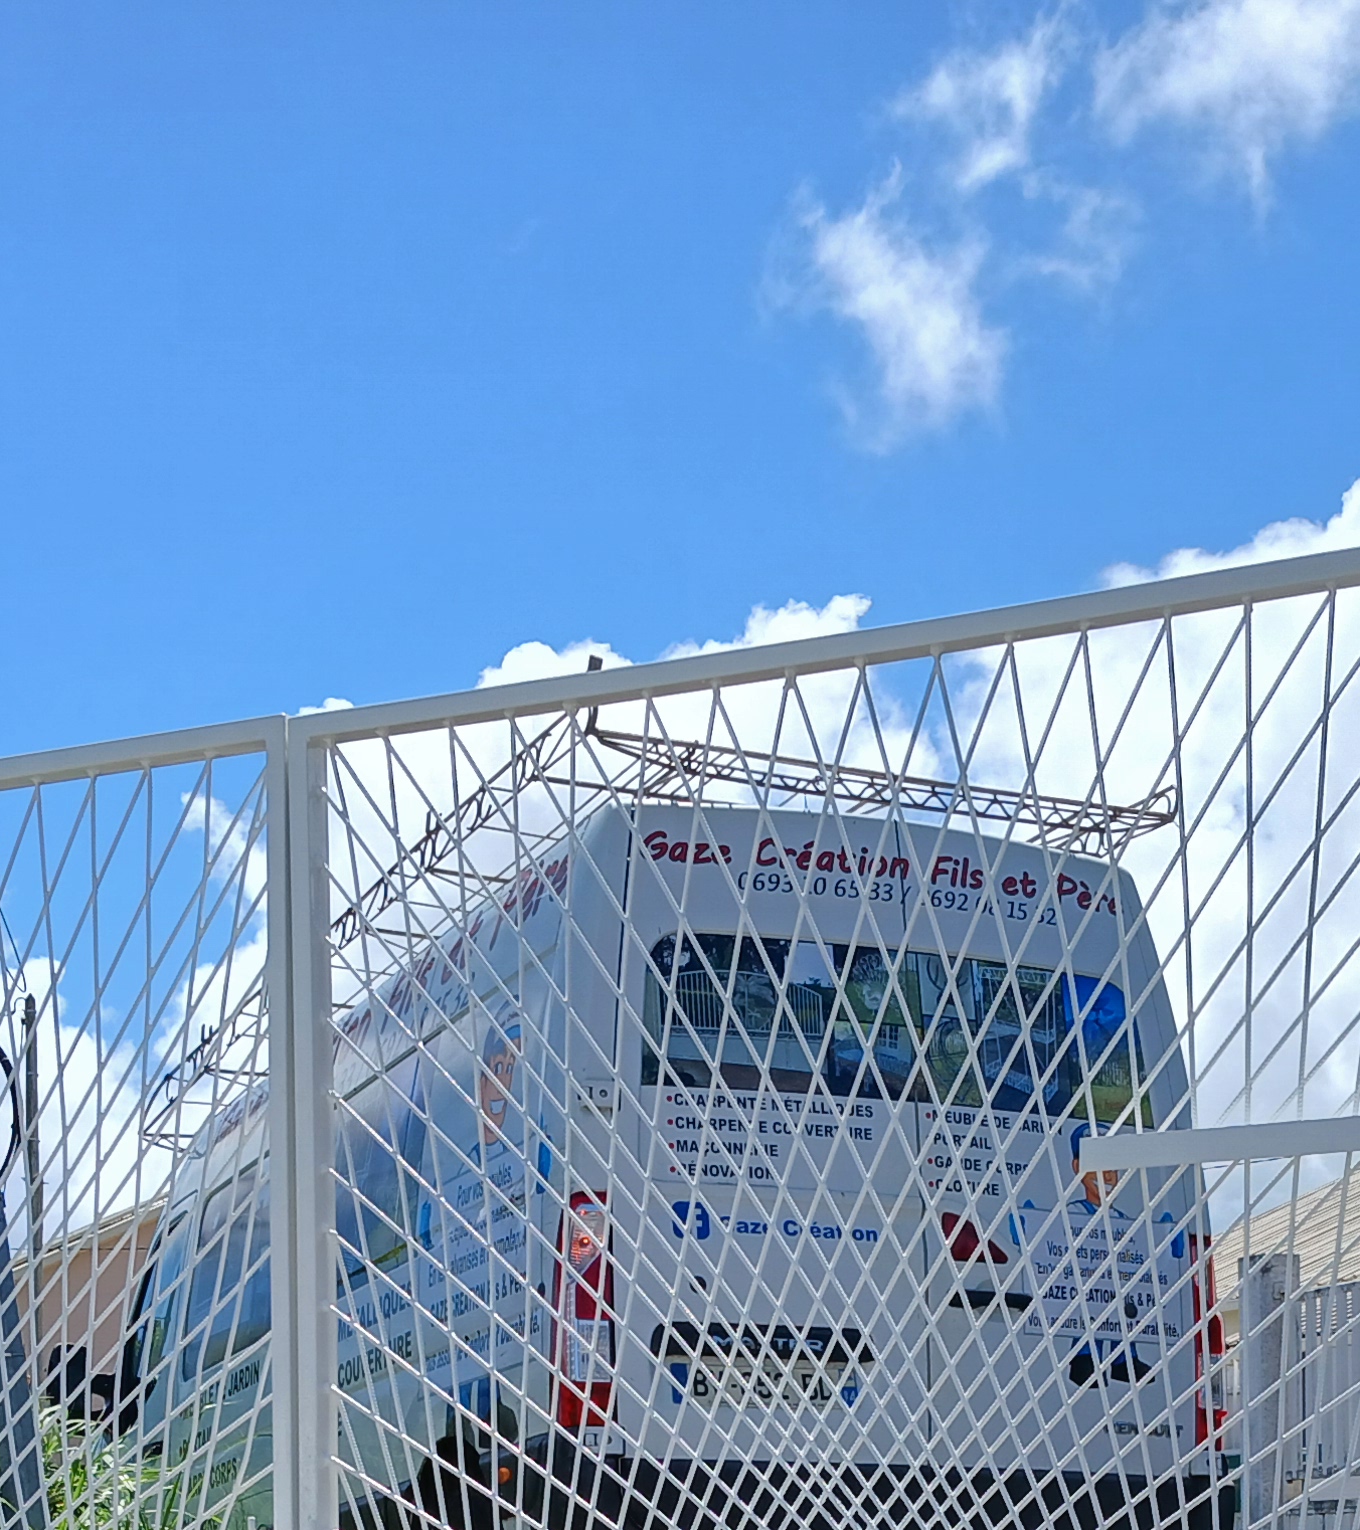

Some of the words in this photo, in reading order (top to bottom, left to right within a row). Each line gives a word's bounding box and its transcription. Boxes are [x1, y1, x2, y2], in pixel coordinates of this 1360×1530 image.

[641, 829, 732, 866] Gaze
[756, 838, 909, 880] Création
[931, 855, 984, 889] Fils
[1002, 871, 1037, 898] et
[1056, 872, 1124, 916] Père
[834, 878, 860, 899] 65
[869, 881, 894, 902] 33
[921, 889, 969, 912] 692
[1007, 900, 1028, 921] 15
[771, 1096, 874, 1119] MÉTLLQUES
[675, 1116, 768, 1133] CHARPENE
[772, 1121, 873, 1141] COVERRE
[993, 1116, 1010, 1130] DE
[1017, 1119, 1063, 1136] ARDN
[676, 1139, 779, 1157] MAÇONNIE
[677, 1160, 777, 1180] ÉNOVAION
[934, 1155, 982, 1172] GADE
[782, 1219, 879, 1243] Céaton
[1047, 1240, 1063, 1257] Vos
[1070, 1286, 1117, 1304] CATION
[712, 1335, 824, 1352] MATER
[338, 1330, 412, 1389] COUERURE
[228, 1360, 259, 1397] JARDIN
[1103, 1421, 1184, 1438] RENULT
[210, 1458, 238, 1489] CORPS
